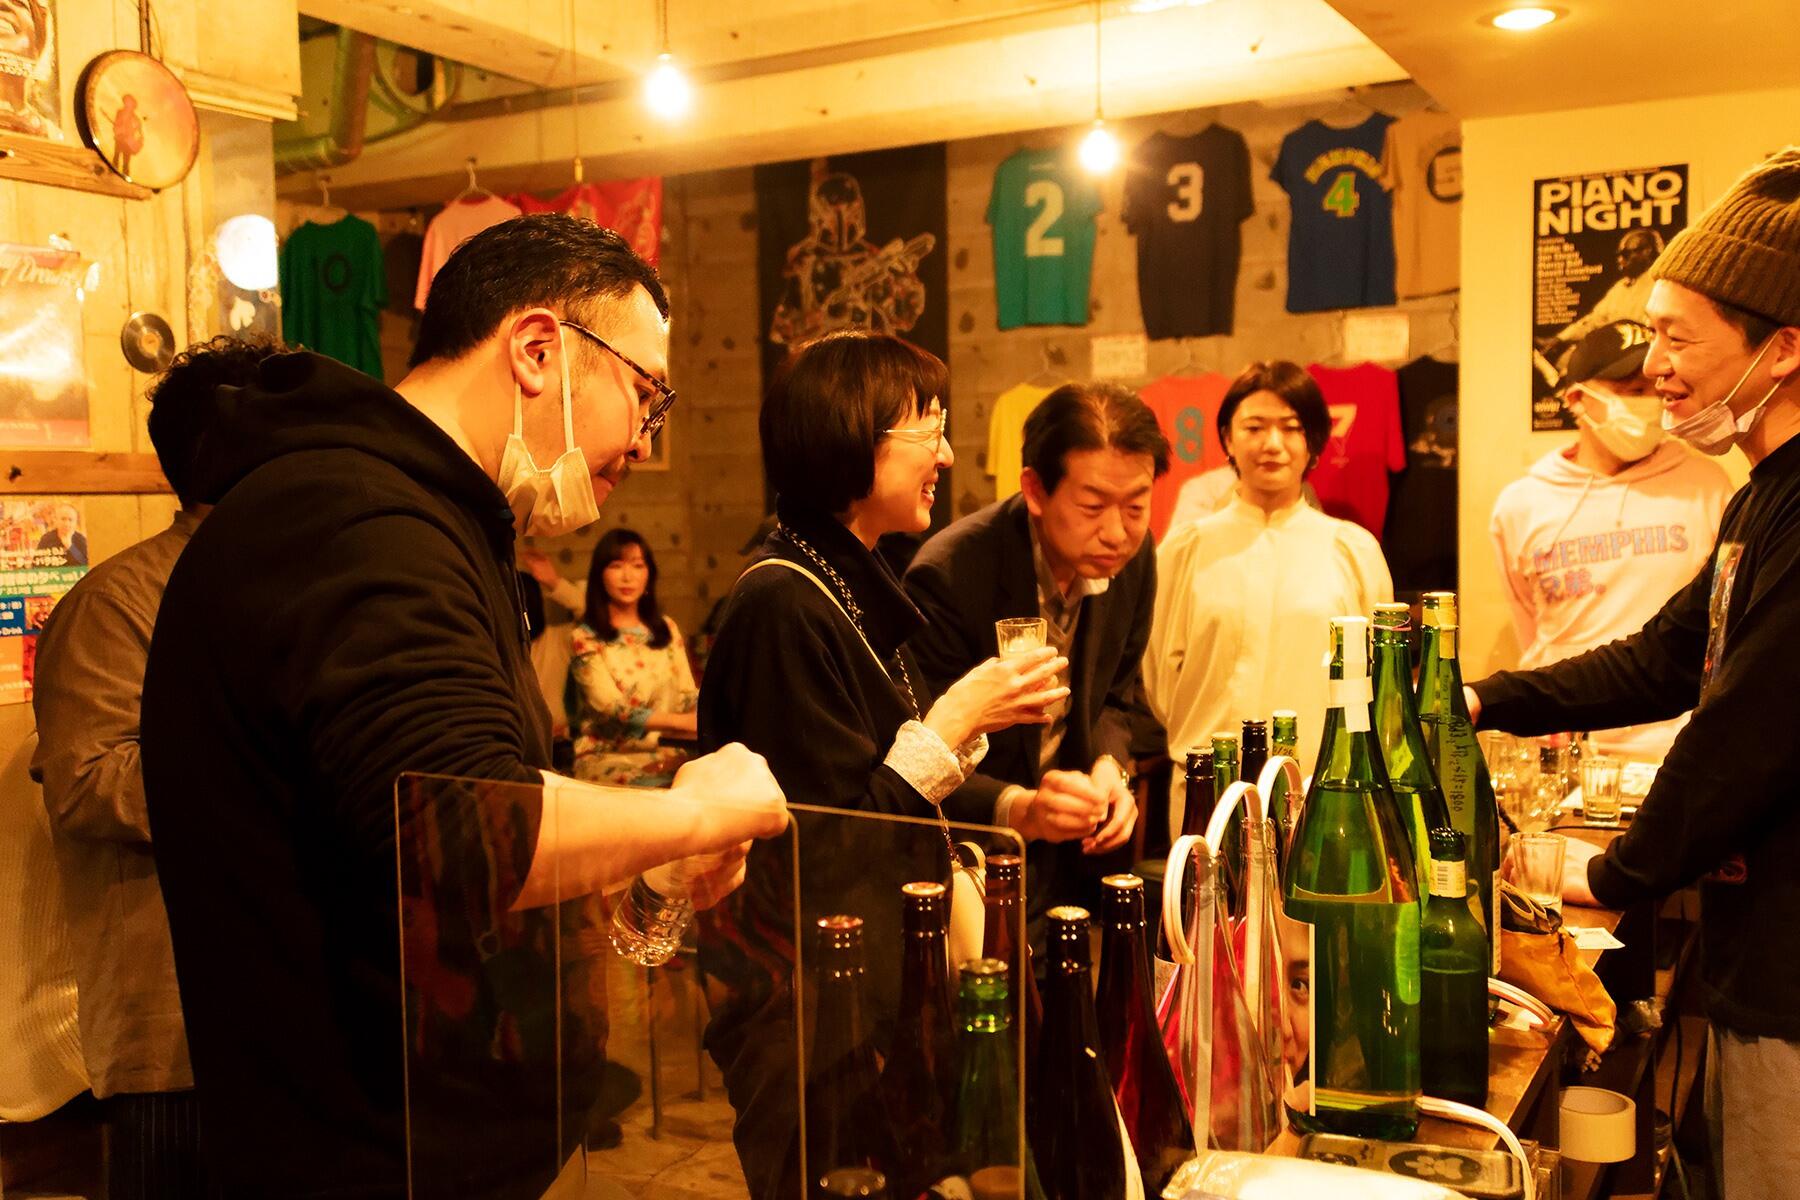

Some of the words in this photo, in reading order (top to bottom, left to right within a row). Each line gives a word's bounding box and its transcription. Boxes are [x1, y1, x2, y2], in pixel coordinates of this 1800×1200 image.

[1166, 161, 1205, 223] 3
[1322, 171, 1360, 217] 4
[1540, 171, 1683, 211] PIANO
[1024, 179, 1065, 258] 2
[1538, 197, 1681, 237] NIGHT
[1174, 406, 1205, 464] 8
[1329, 403, 1358, 438] 7
[1533, 524, 1690, 574] MEMPHIS
